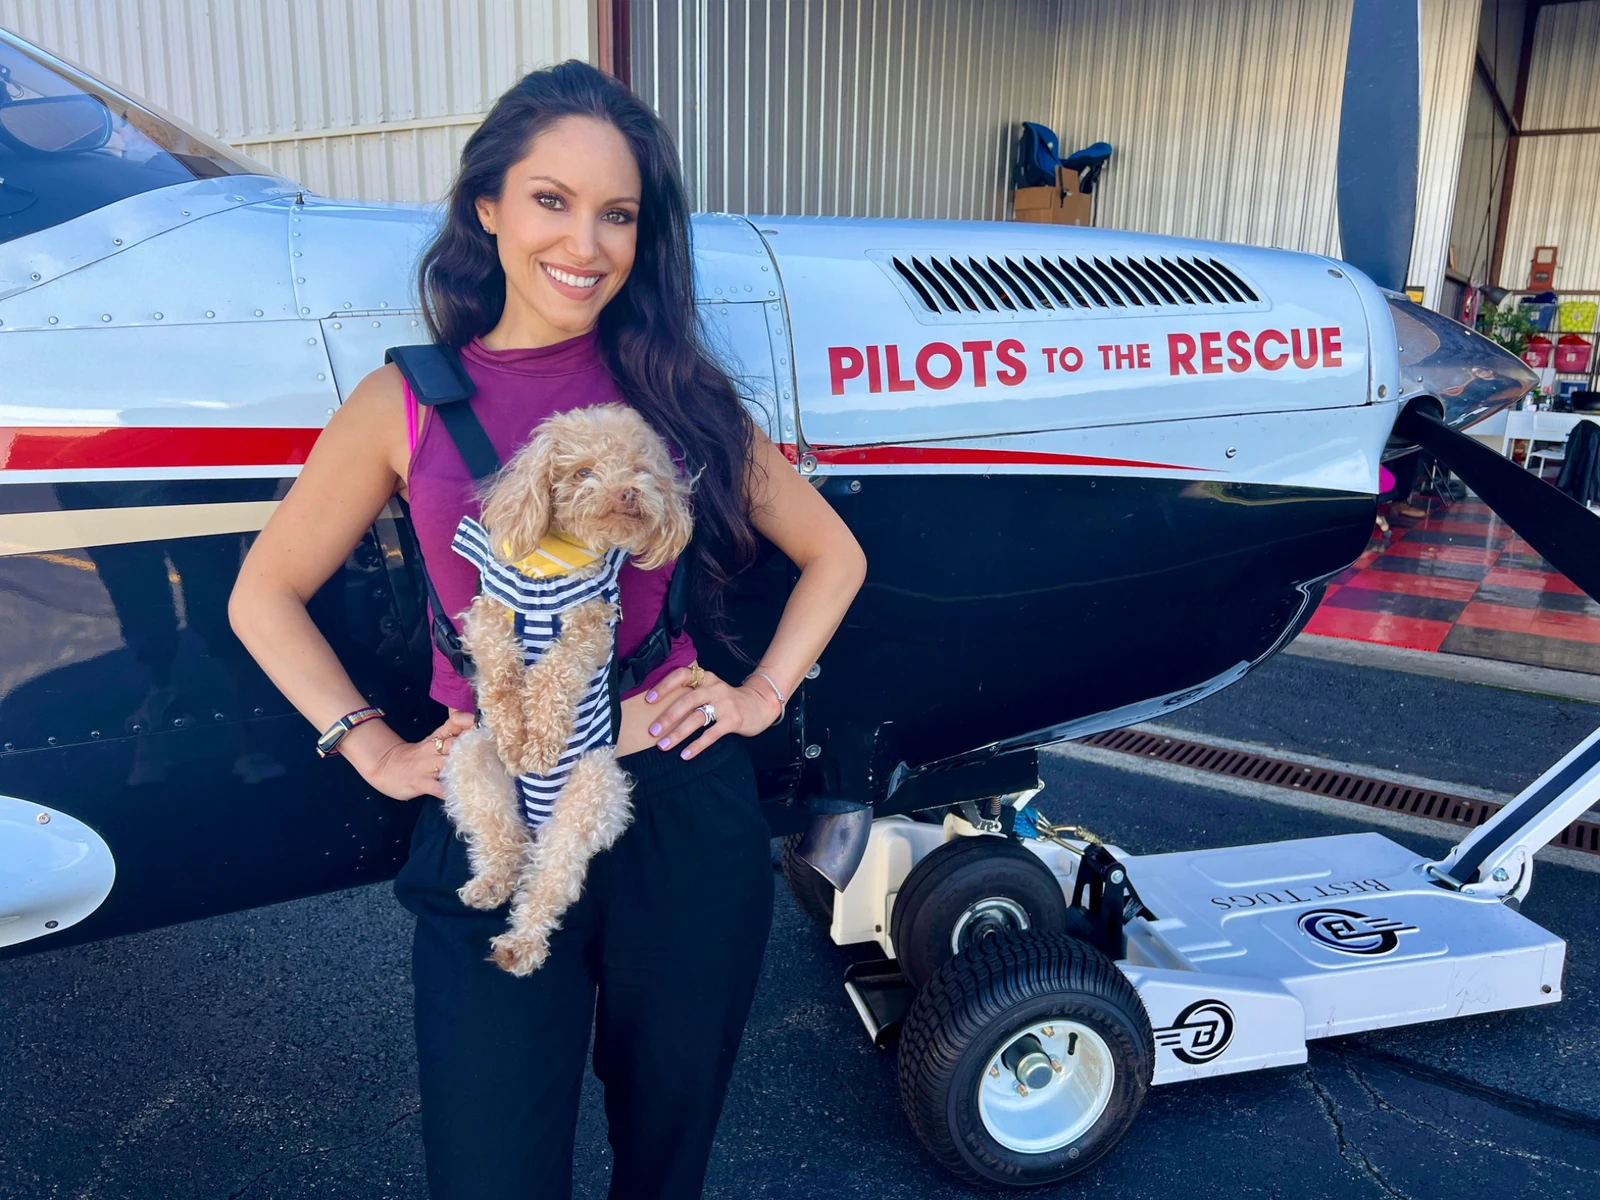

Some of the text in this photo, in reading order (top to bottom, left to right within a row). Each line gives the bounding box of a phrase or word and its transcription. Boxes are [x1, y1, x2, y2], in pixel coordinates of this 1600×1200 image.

[828, 327, 1342, 395] PILOTS TO THE RESCUE
[1210, 879, 1392, 910] BEST TUGS
